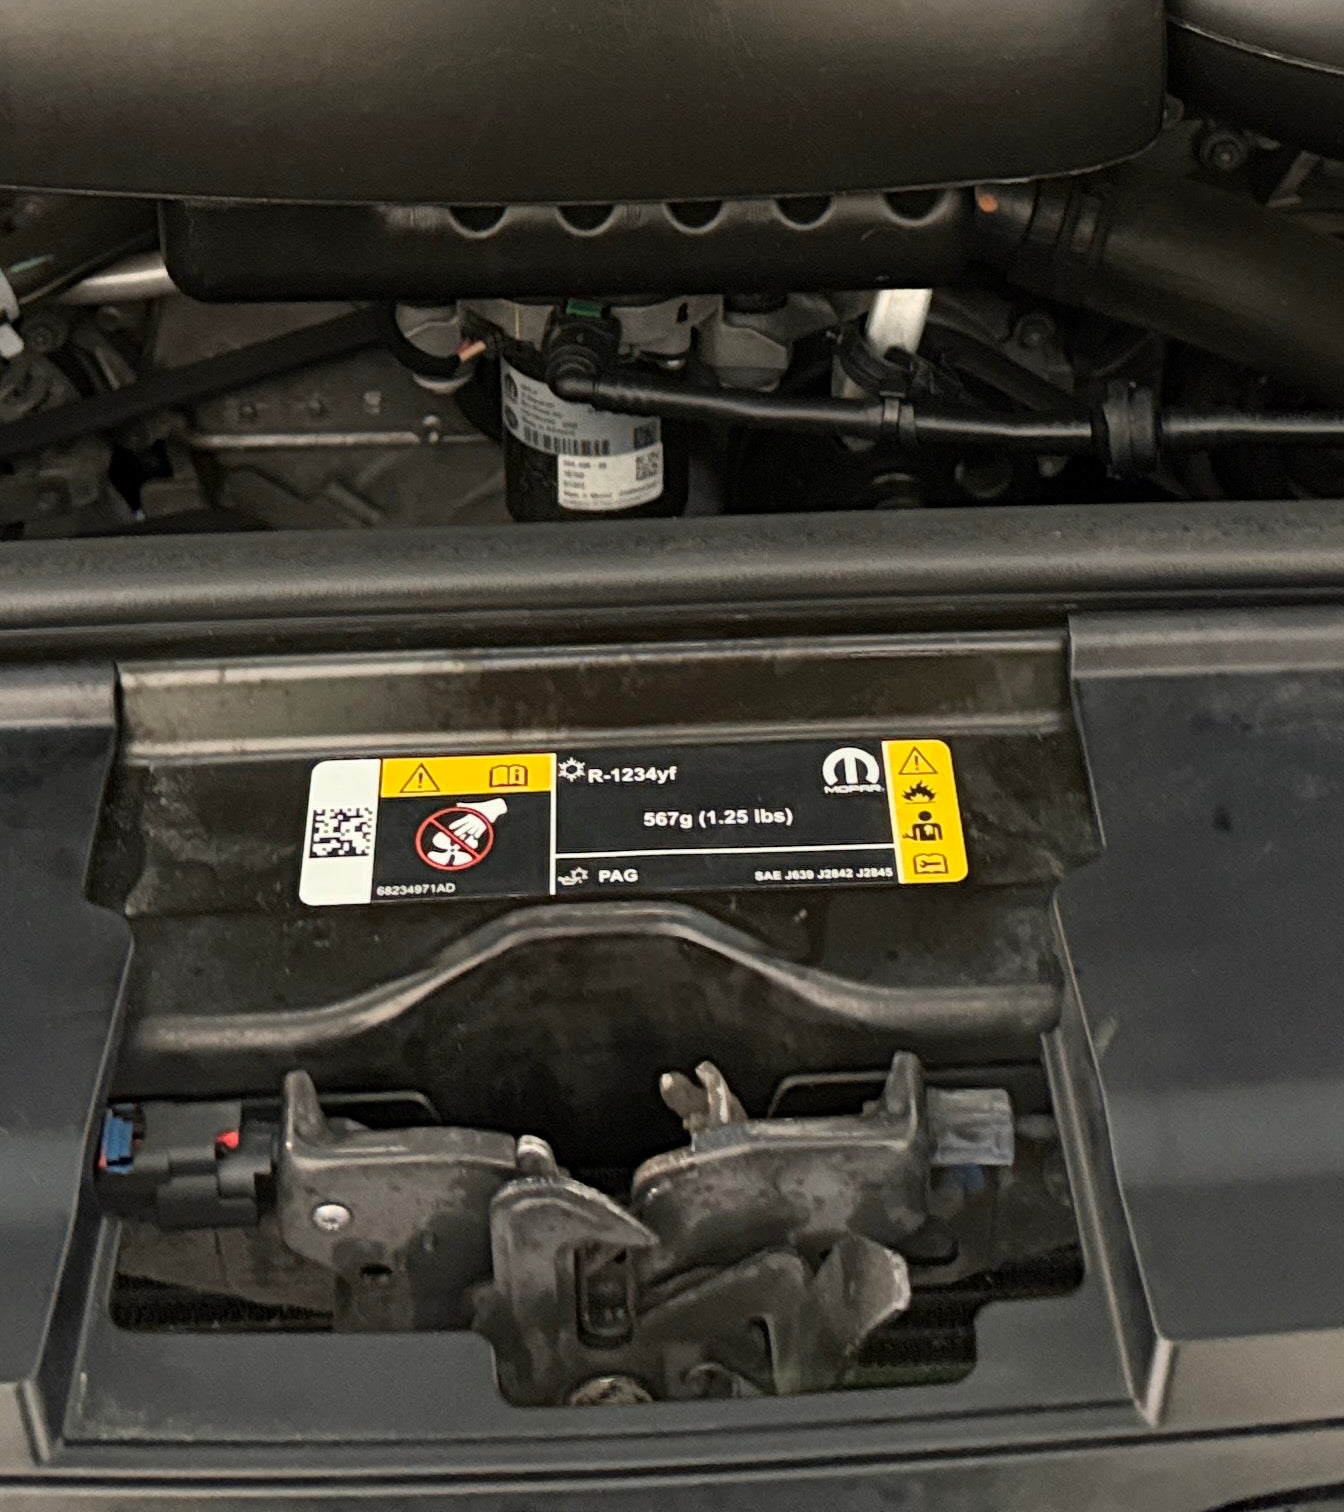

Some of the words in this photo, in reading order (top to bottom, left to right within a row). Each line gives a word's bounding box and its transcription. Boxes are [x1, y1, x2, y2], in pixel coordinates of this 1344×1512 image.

[588, 765, 677, 785] R-1234yf
[824, 784, 883, 794] MOPAR
[643, 811, 693, 829] 567g
[699, 809, 749, 828] (1.25
[754, 807, 794, 827] lbs)
[598, 868, 639, 883] PAG
[754, 870, 782, 882] SAE
[785, 868, 814, 881] J639
[817, 868, 854, 880] J2842
[856, 866, 894, 879] J2845
[376, 882, 456, 896] 68234971AD
